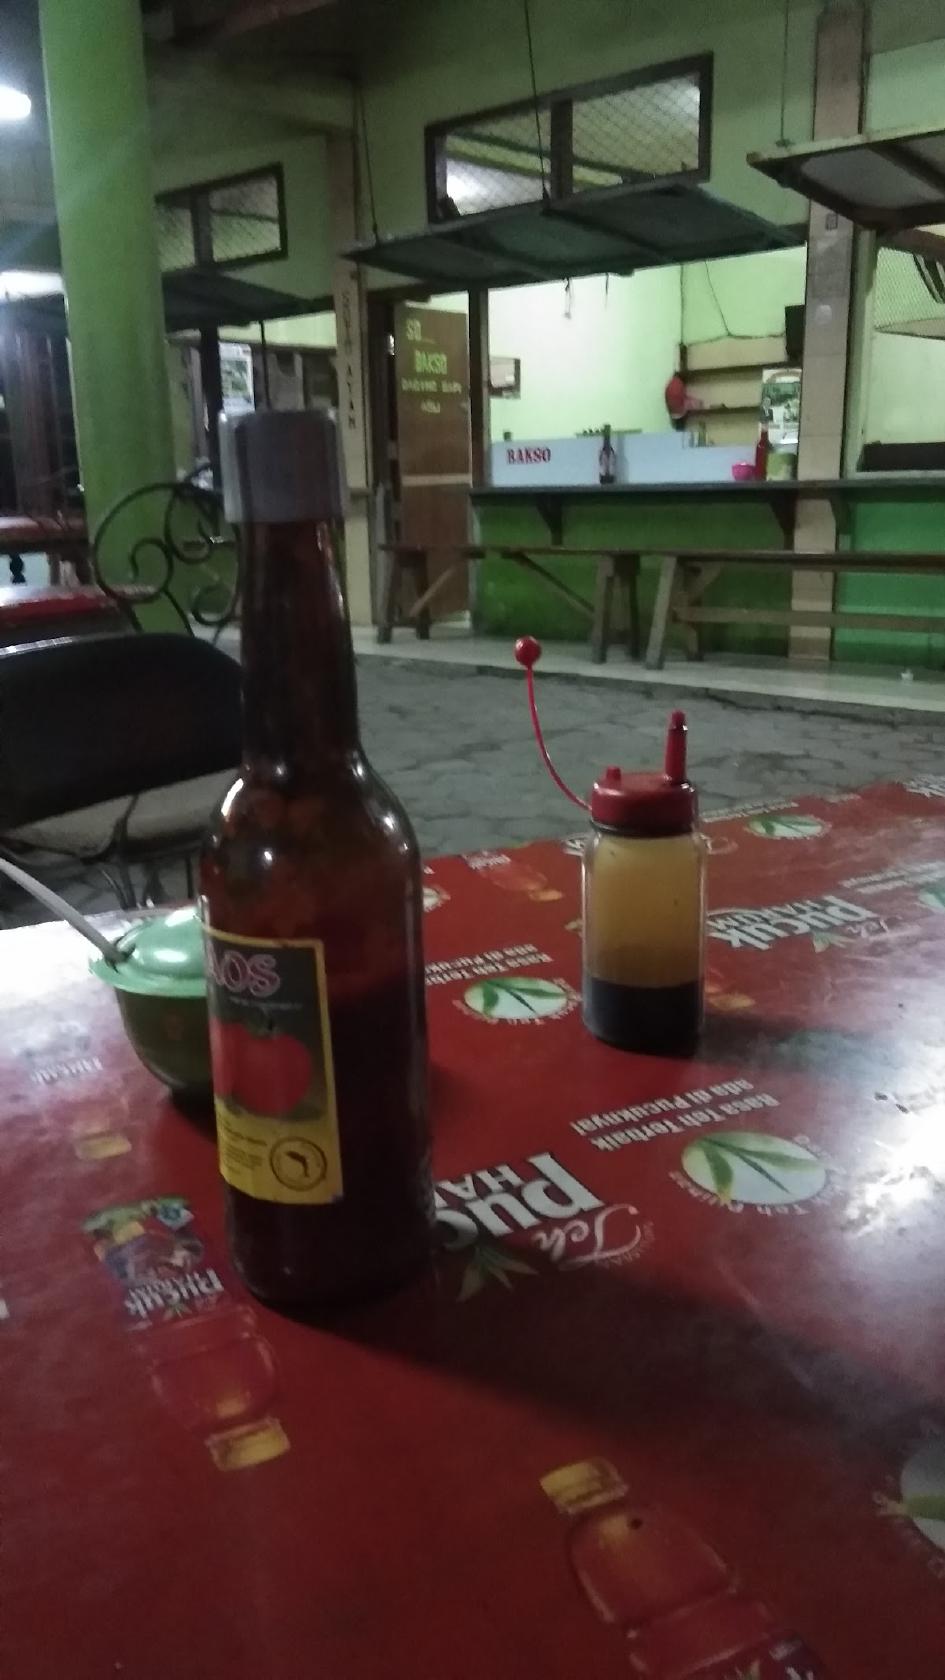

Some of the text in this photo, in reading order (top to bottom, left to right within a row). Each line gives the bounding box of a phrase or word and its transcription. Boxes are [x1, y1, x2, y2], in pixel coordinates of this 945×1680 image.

[414, 349, 448, 375] BAKSO
[506, 446, 551, 465] BAKSO
[569, 1077, 755, 1136] ada di Pucuknya!
[676, 1107, 725, 1128] Teh
[590, 1118, 684, 1152] Terbaik
[531, 1203, 641, 1272] Teh
